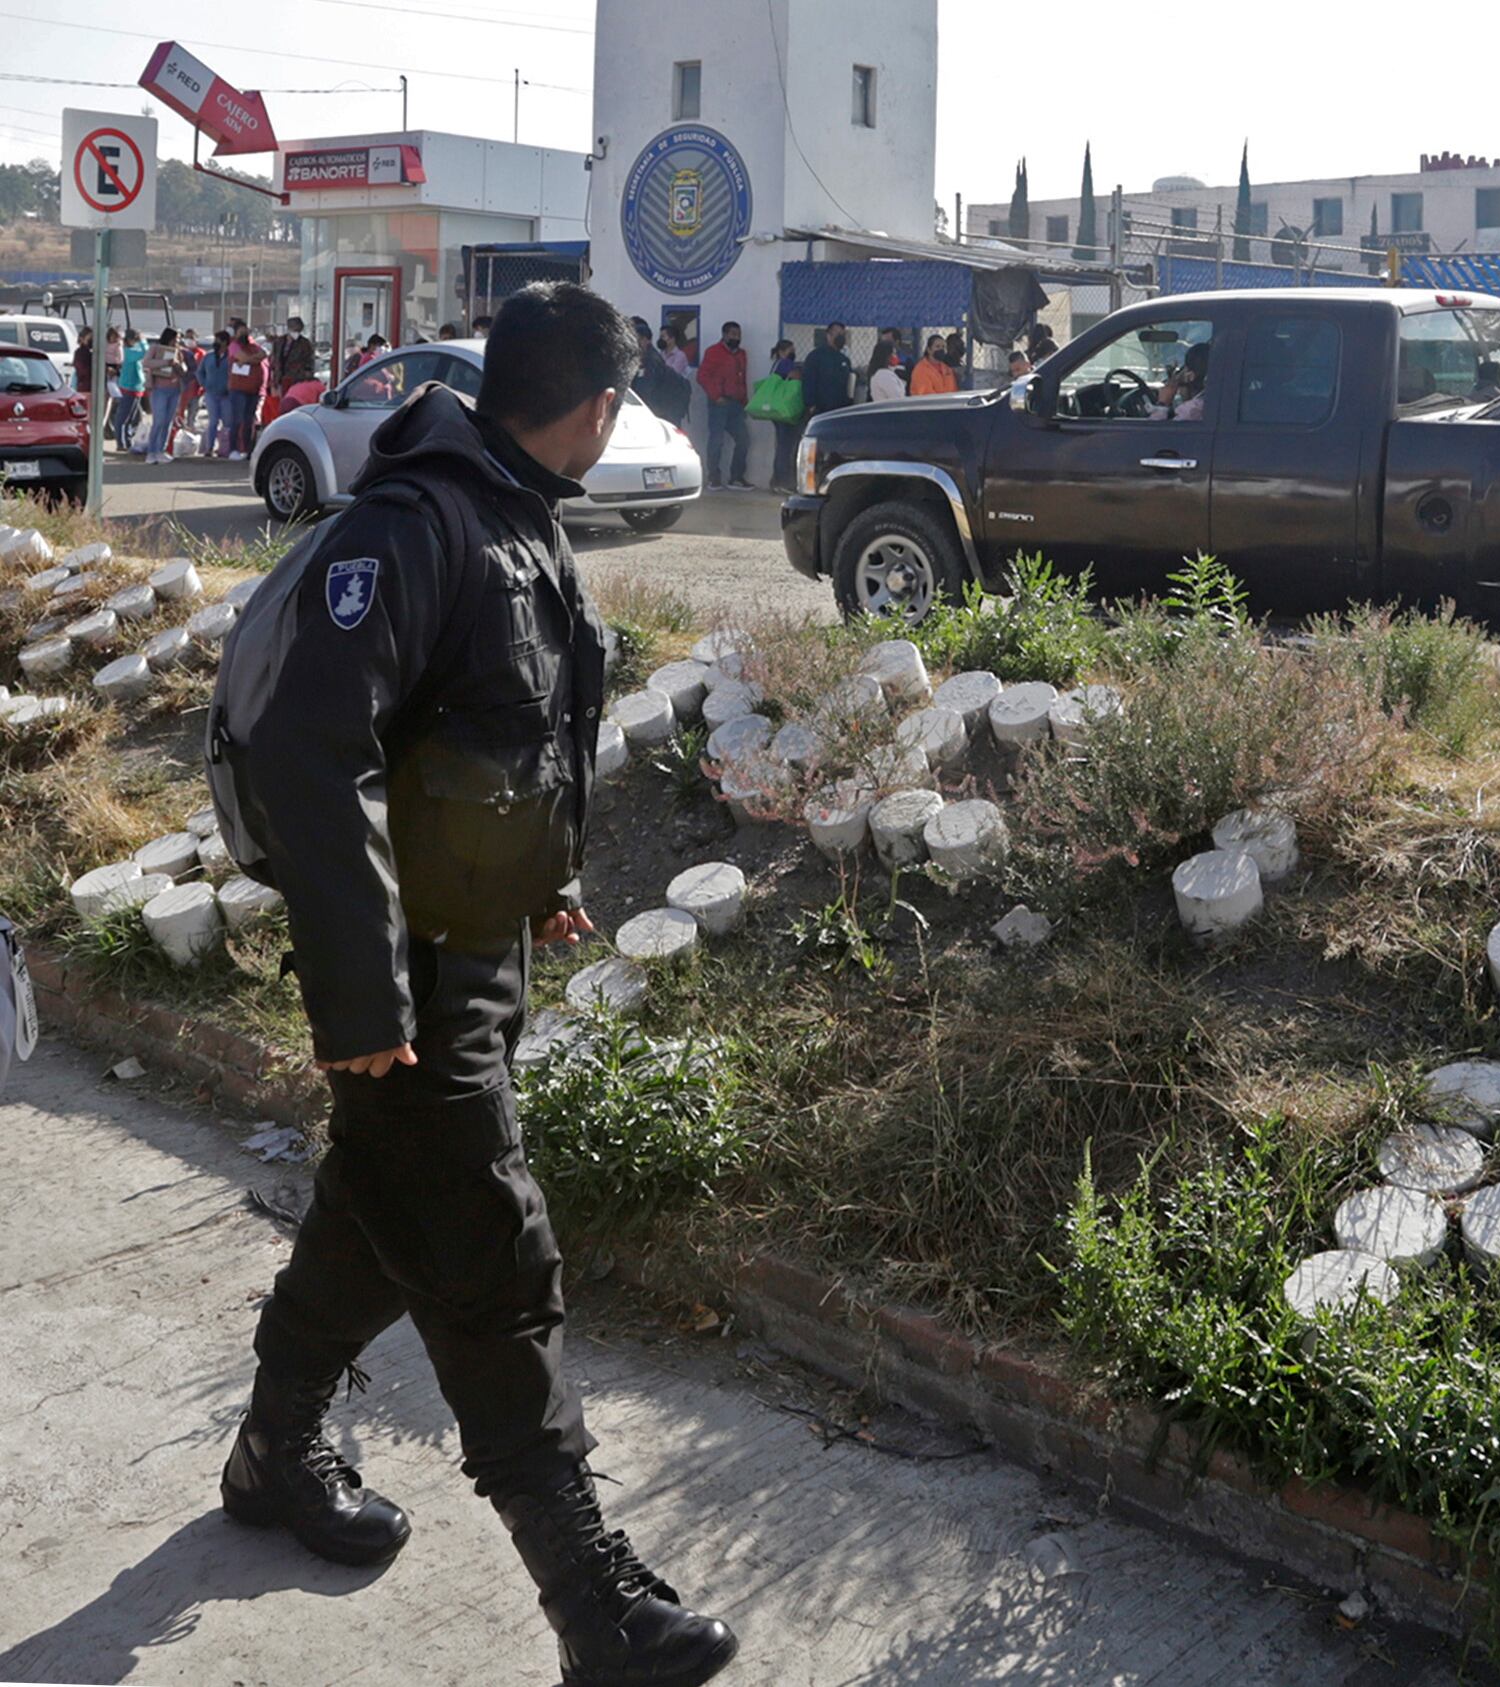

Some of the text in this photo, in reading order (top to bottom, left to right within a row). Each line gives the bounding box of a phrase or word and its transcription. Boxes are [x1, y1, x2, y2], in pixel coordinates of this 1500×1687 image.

[177, 70, 201, 93] RED
[216, 93, 258, 130] CAJERO
[223, 116, 243, 134] ATM
[658, 141, 668, 151] DE
[673, 132, 717, 148] SEGURIDAD
[97, 145, 121, 195] E
[301, 164, 366, 181] BANORTE
[381, 159, 396, 168] RED
